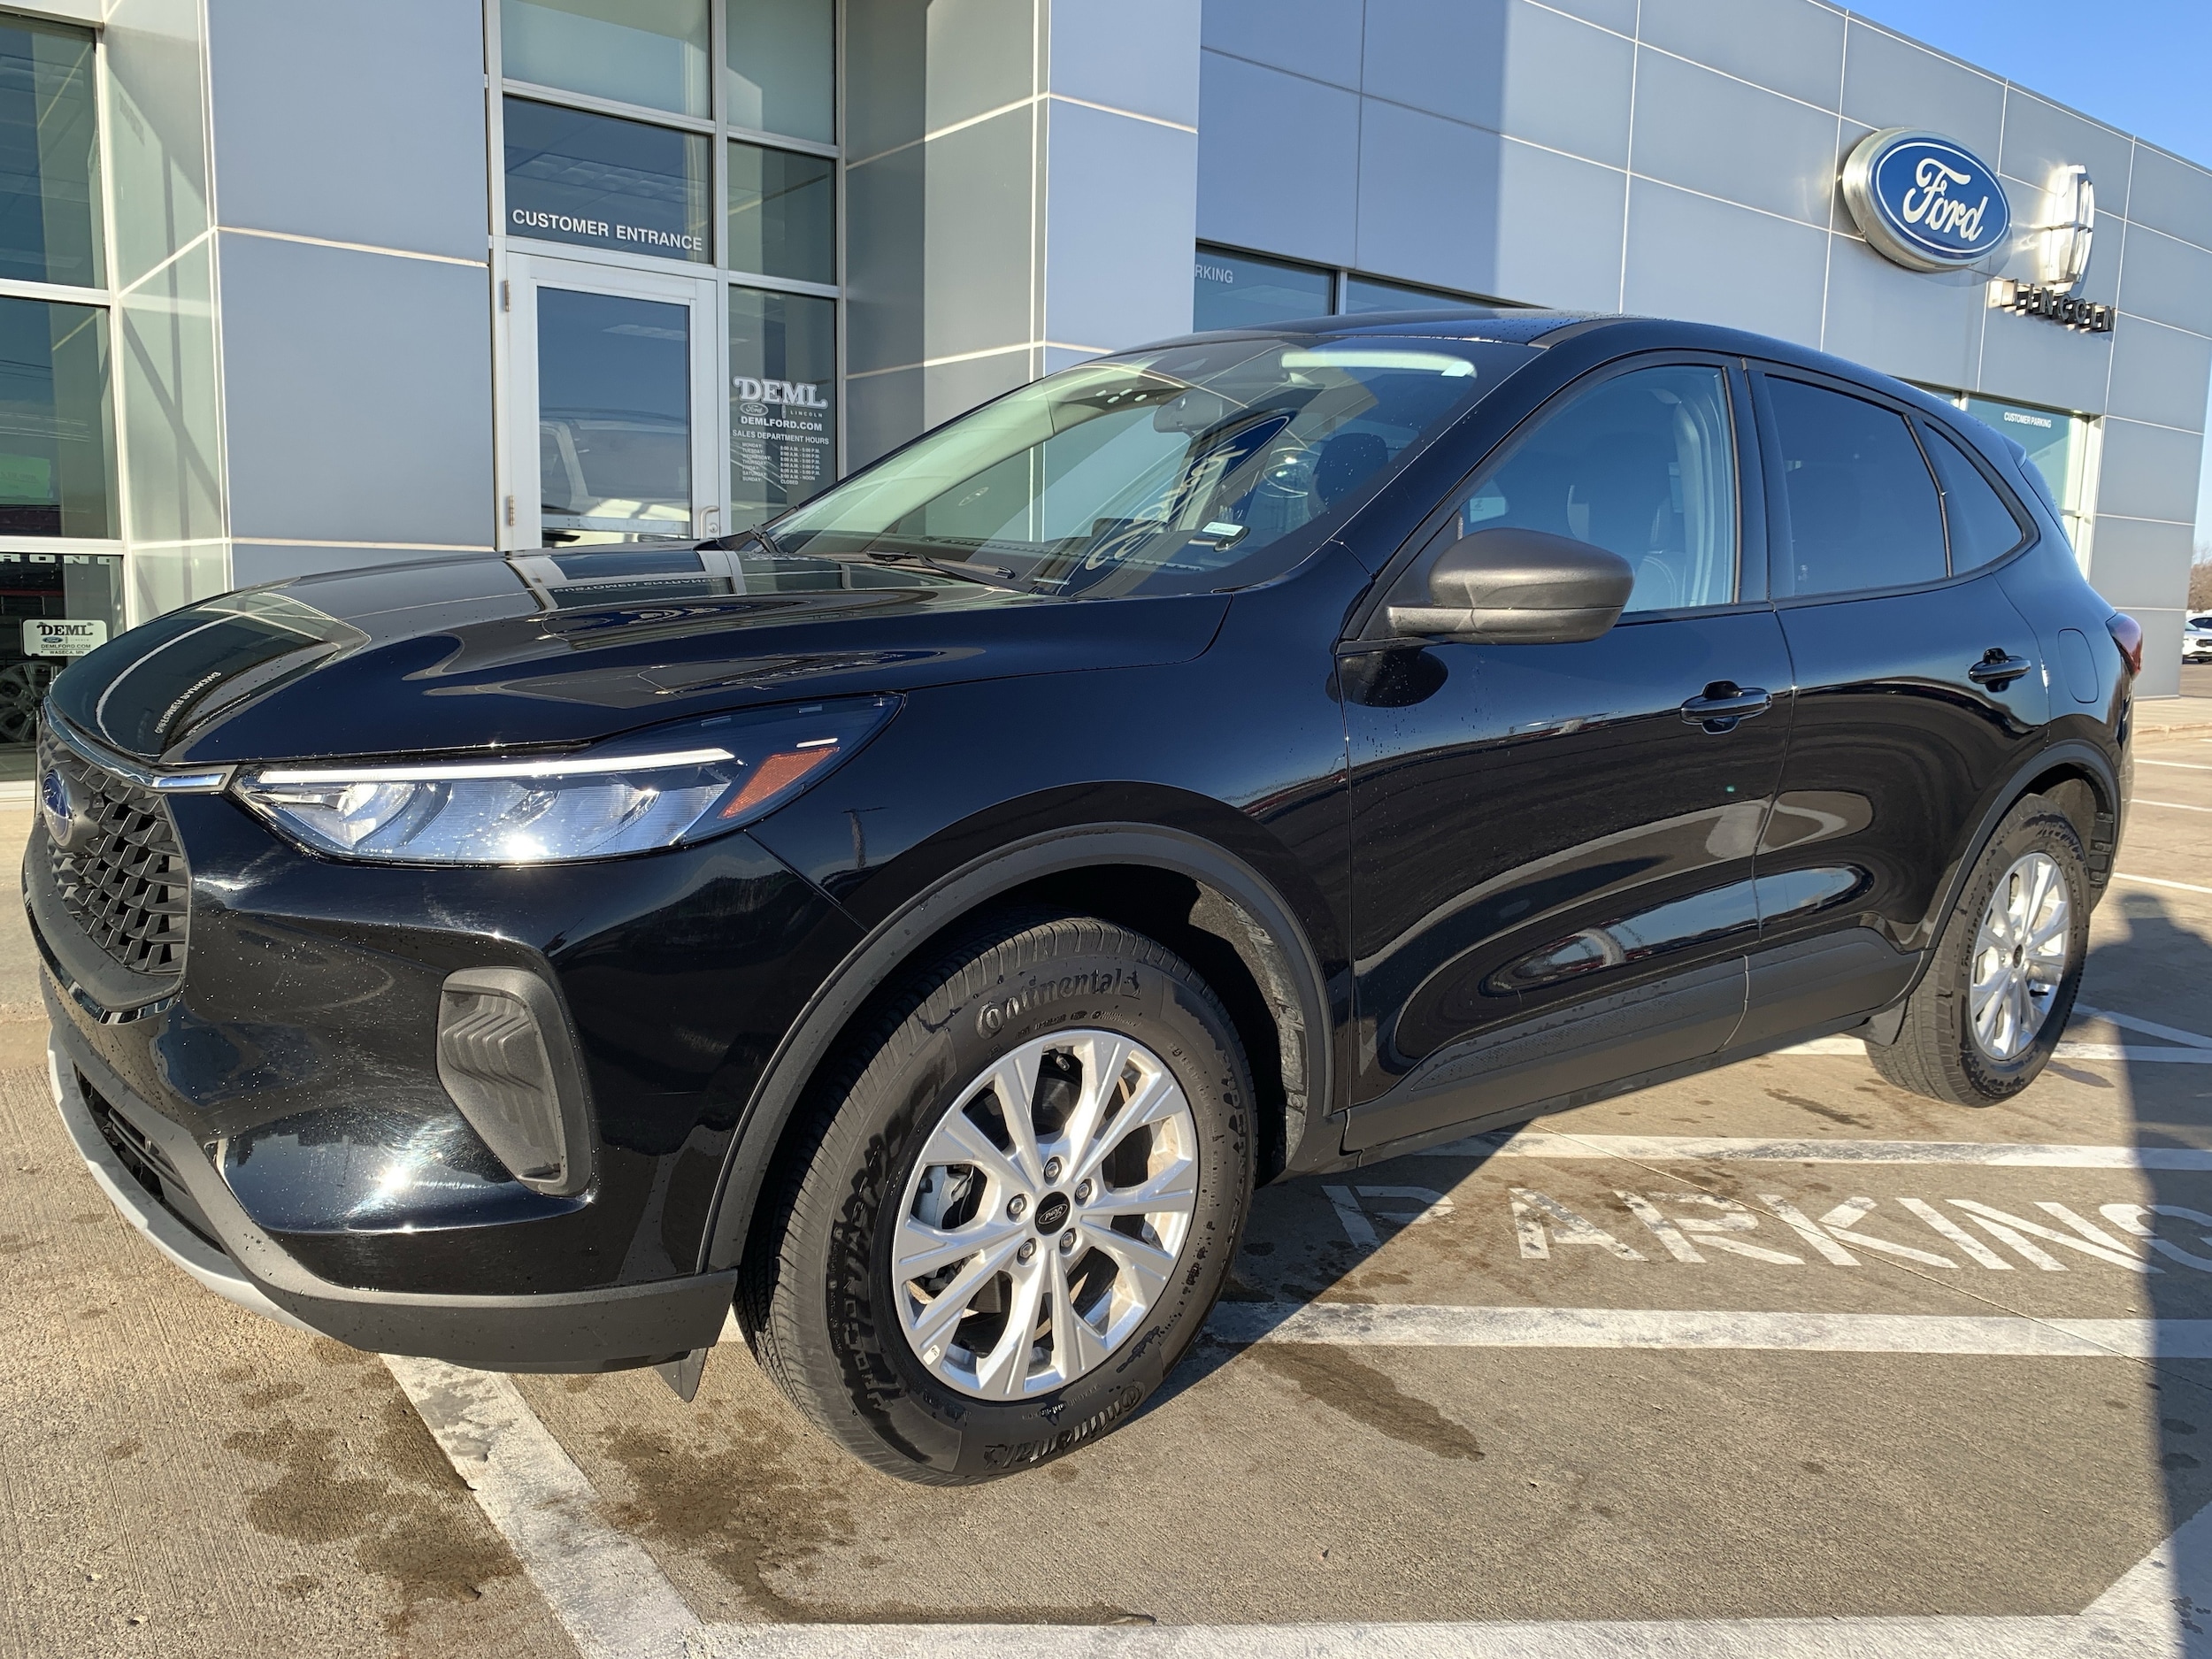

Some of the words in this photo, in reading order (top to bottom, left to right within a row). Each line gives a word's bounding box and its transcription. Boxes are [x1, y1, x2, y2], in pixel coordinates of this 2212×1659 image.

[1902, 157, 1990, 242] Ford
[512, 209, 610, 237] CUSTOMER
[616, 224, 703, 251] ENTRANCE
[2013, 278, 2116, 331] LINCOLN
[733, 376, 828, 409] DEML
[741, 416, 823, 432] DEMLFORD.COM
[2003, 411, 2032, 426] CUSTOMER
[2031, 416, 2052, 429] PARKING
[732, 429, 756, 439] SALES
[757, 432, 804, 442] DEPARTMENT
[805, 435, 830, 445] HOURS
[36, 625, 94, 636] DEML
[974, 968, 1123, 1040] Continental
